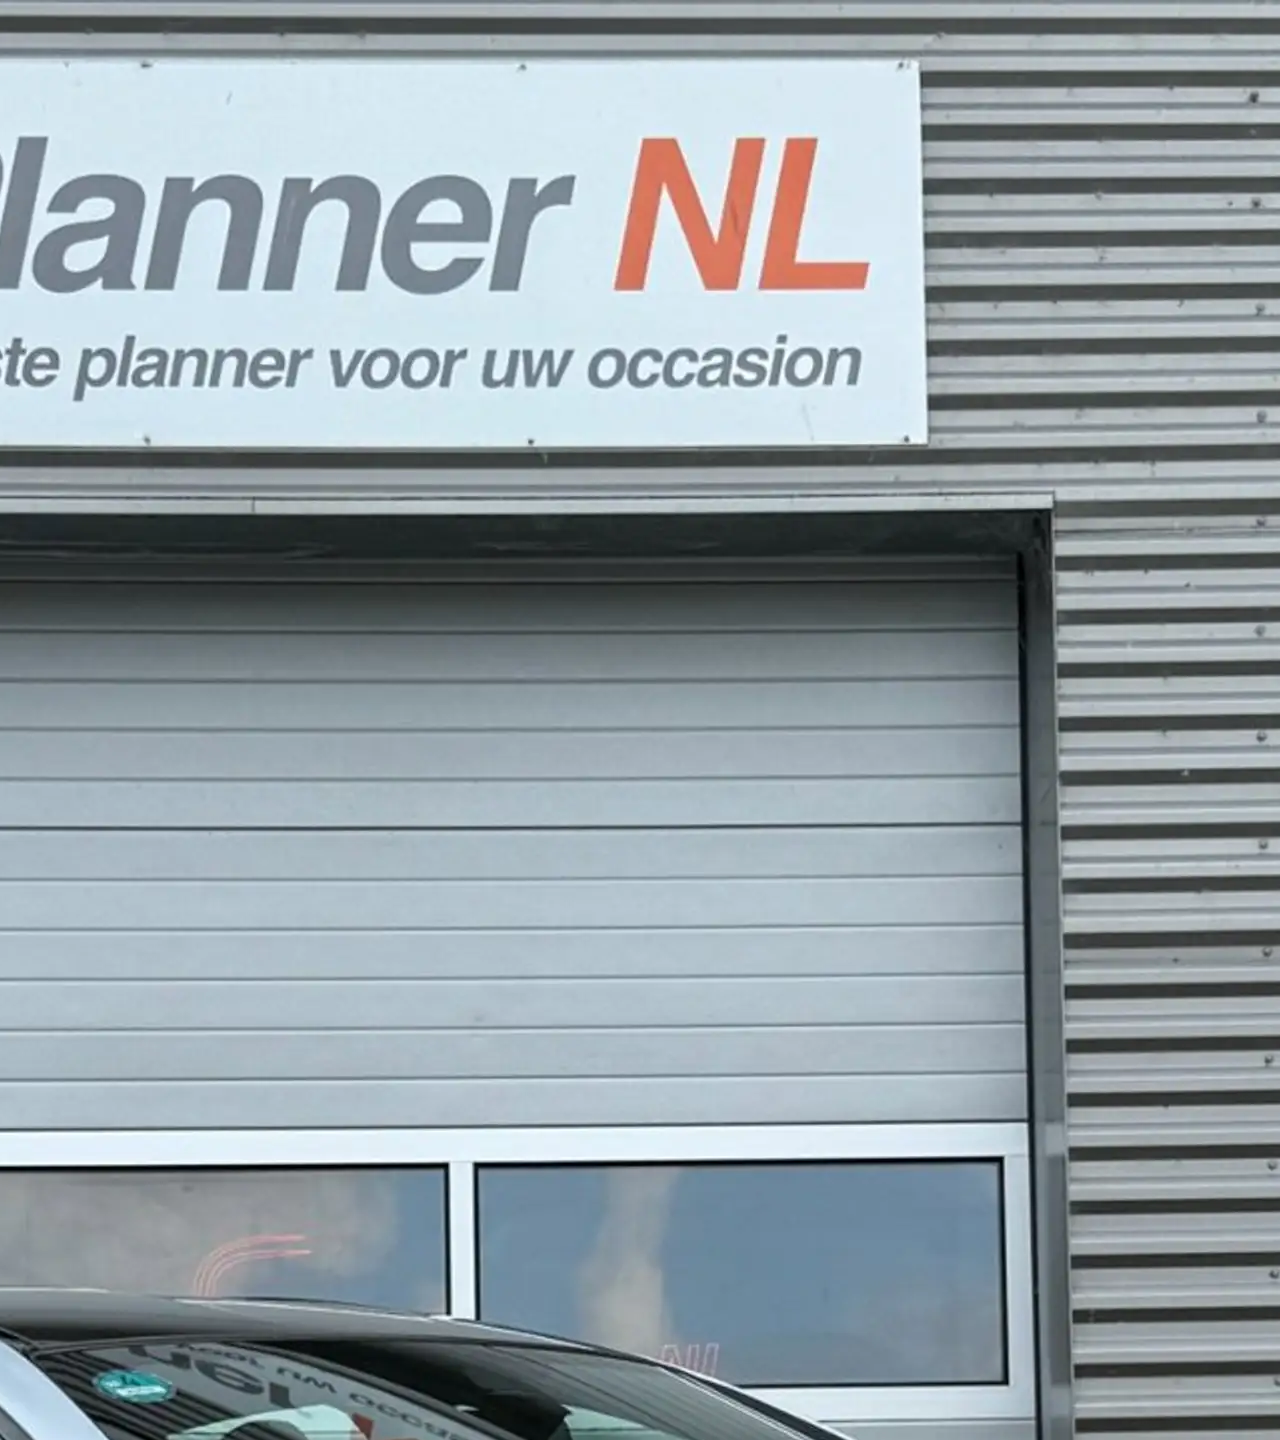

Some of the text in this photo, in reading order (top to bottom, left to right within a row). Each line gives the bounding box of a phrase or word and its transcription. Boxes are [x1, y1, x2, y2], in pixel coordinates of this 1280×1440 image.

[613, 136, 870, 291] NL
[73, 335, 314, 401] planner
[329, 348, 468, 389] voor
[482, 348, 574, 389] uw
[587, 334, 862, 389] occasion
